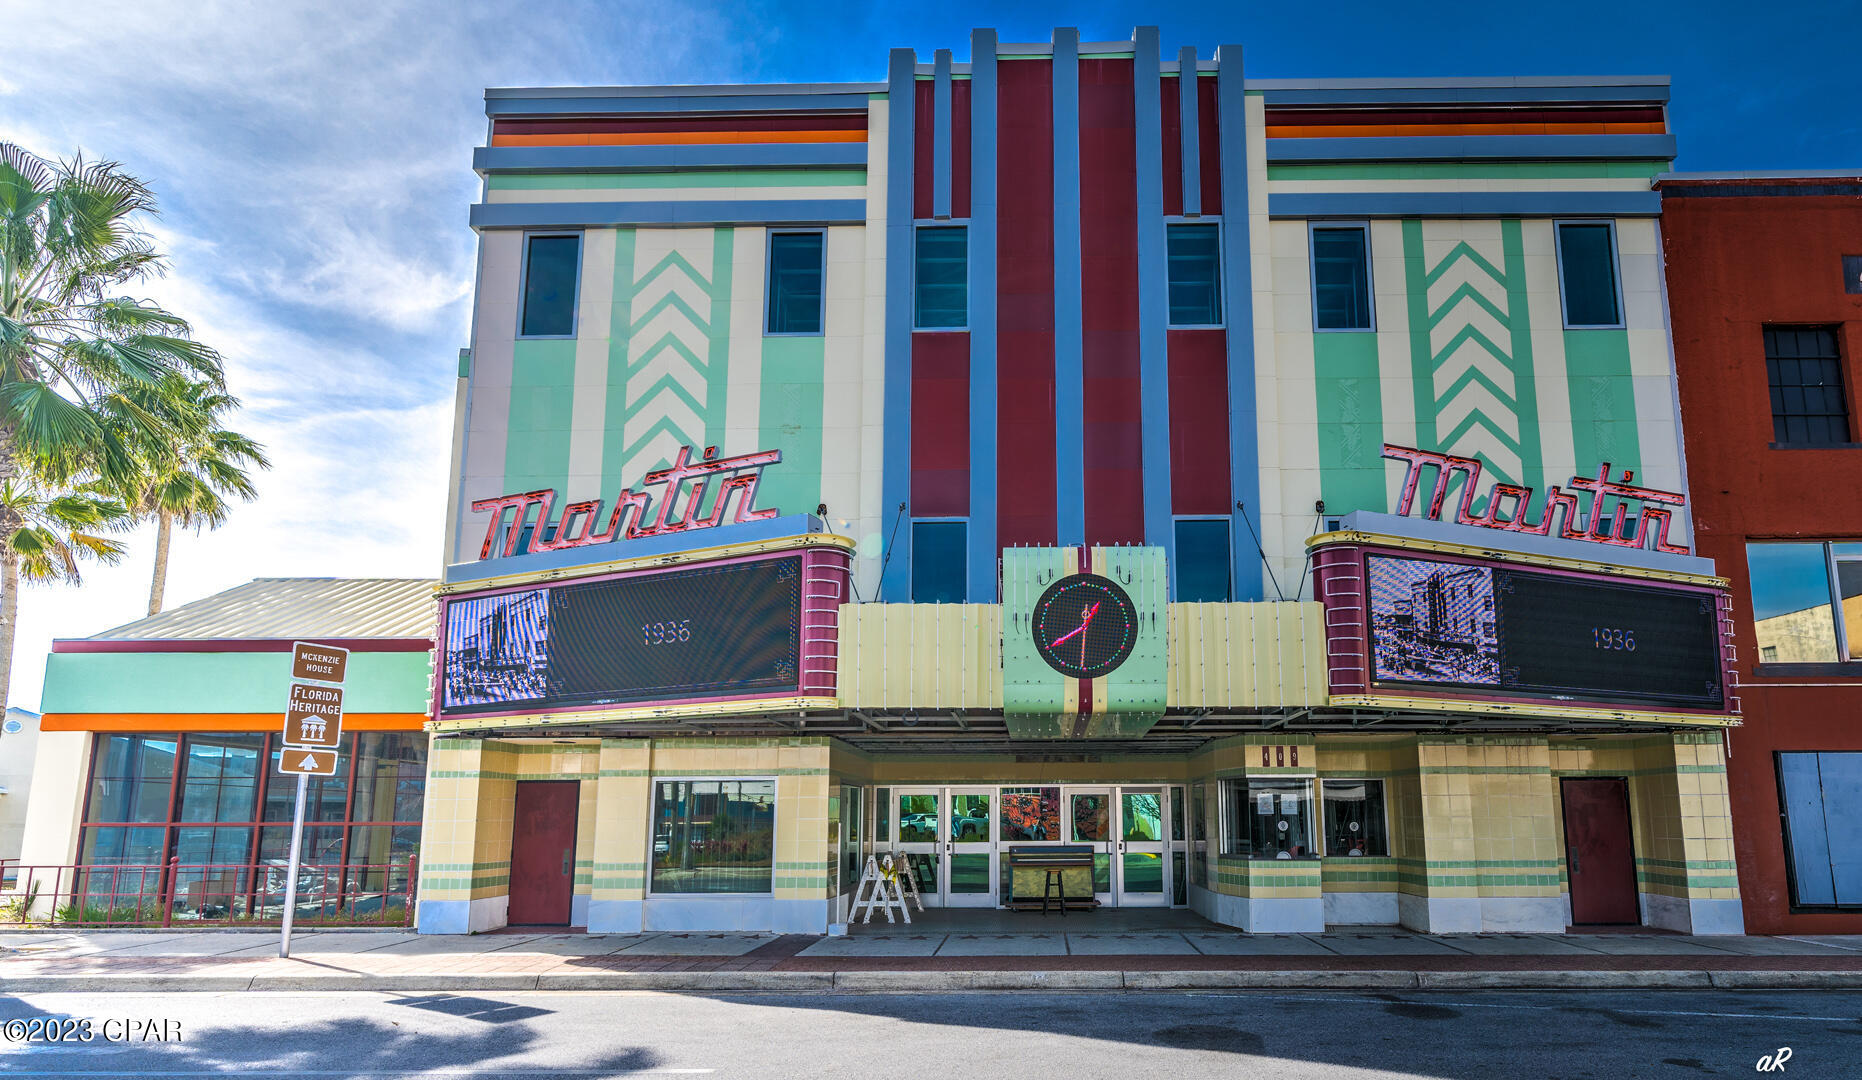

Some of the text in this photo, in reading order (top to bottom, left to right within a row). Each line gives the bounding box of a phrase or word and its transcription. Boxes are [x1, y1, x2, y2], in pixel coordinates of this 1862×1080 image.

[471, 445, 782, 560] Martin
[1380, 443, 1690, 555] Martin
[641, 619, 690, 645] 1936
[1592, 627, 1636, 651] 1936
[301, 652, 340, 665] MCKENZIE
[306, 664, 333, 674] HOUSE
[294, 686, 339, 702] FLORIDA
[289, 700, 340, 715] HERITAGE
